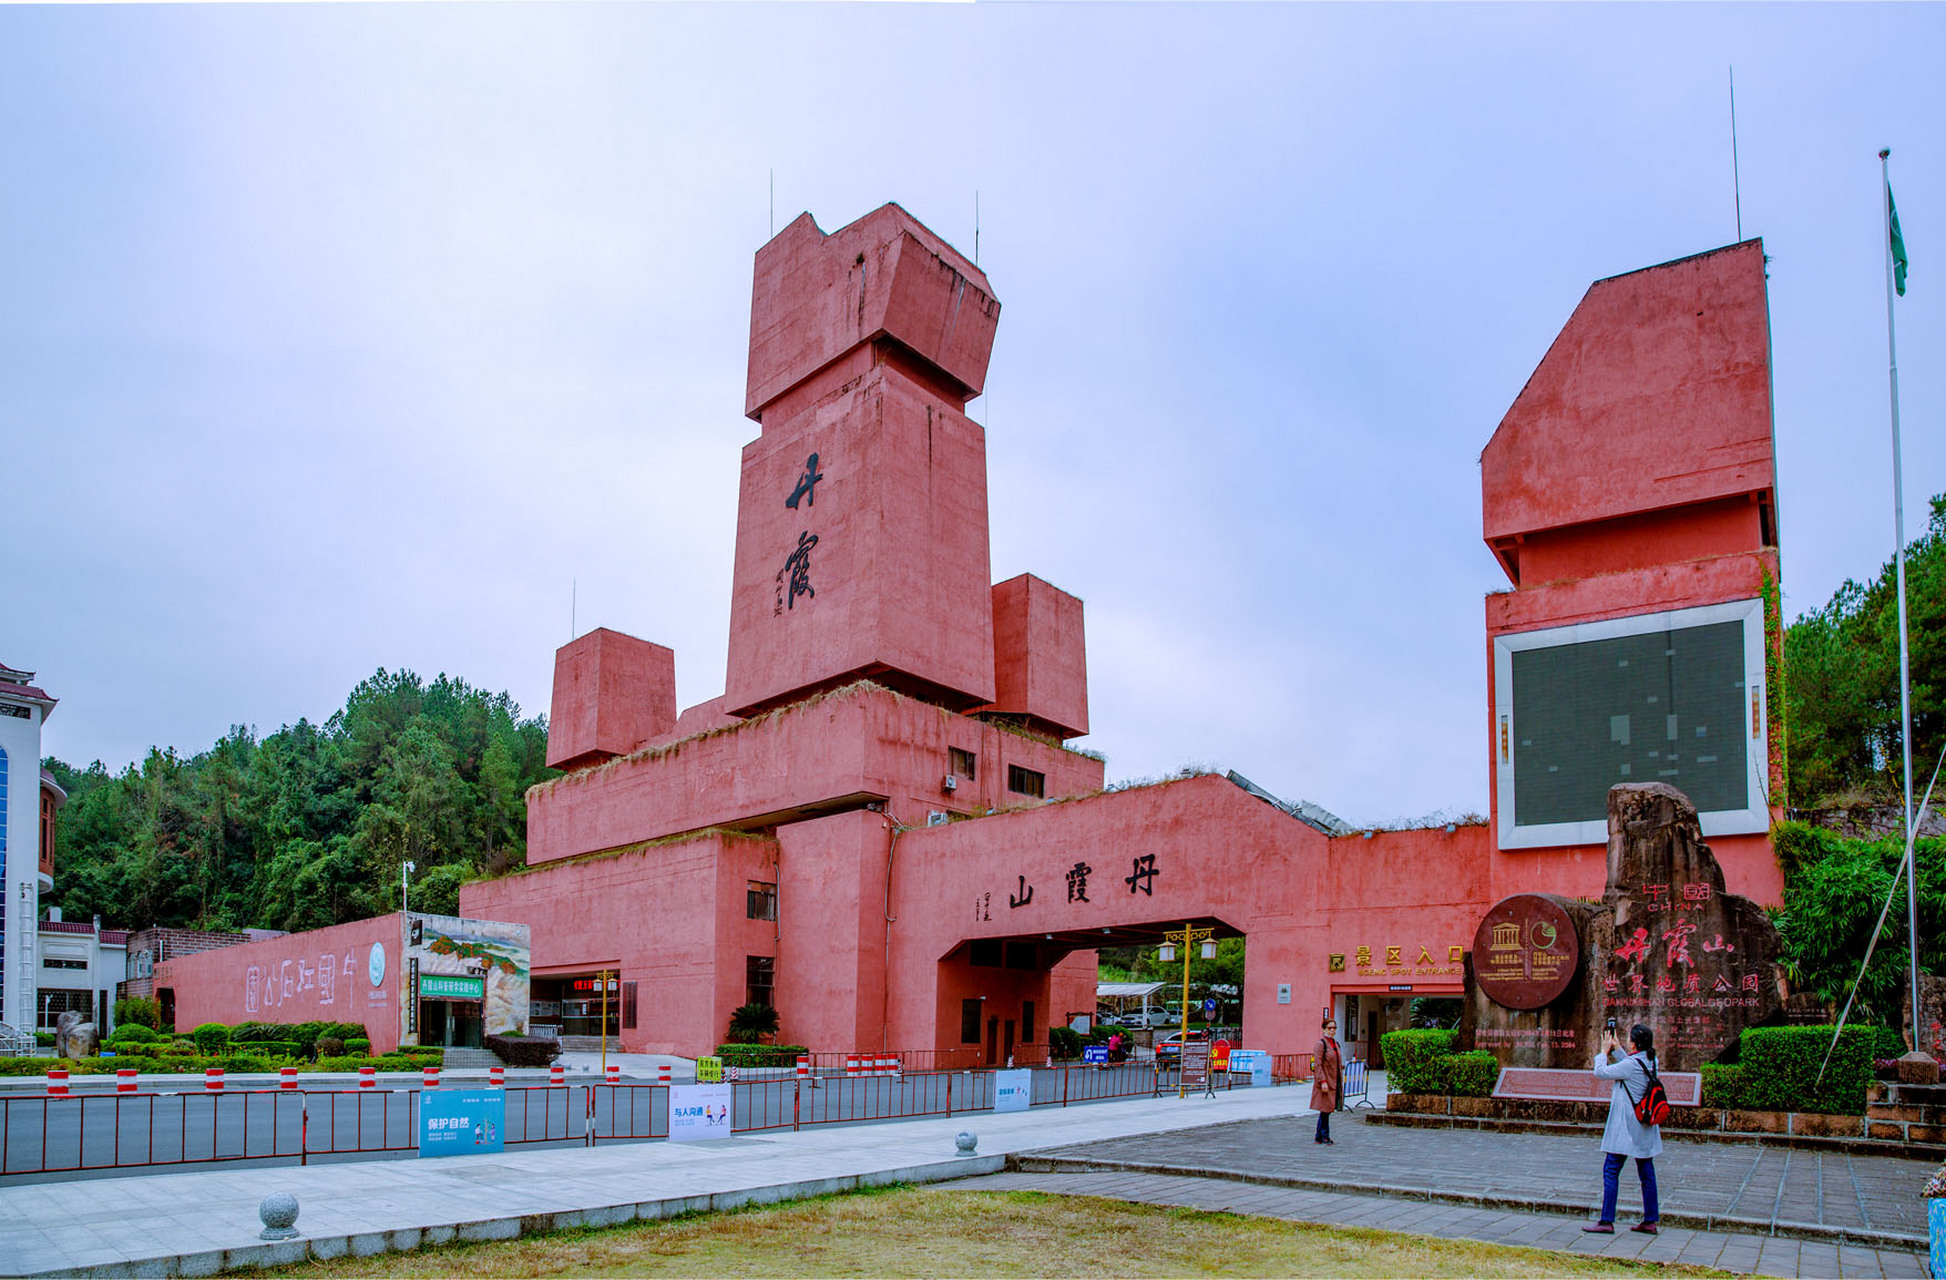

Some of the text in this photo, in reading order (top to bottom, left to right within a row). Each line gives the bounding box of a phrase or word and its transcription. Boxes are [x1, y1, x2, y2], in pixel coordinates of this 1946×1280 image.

[785, 452, 823, 610] 丹霞
[1647, 903, 1704, 912] CHINA
[1356, 945, 1464, 966] 景区入口
[1358, 967, 1462, 976] SCENIC SPOT ENTRANCE
[1602, 973, 1759, 994] 世界地质公园
[428, 1117, 470, 1130] 保护自然
